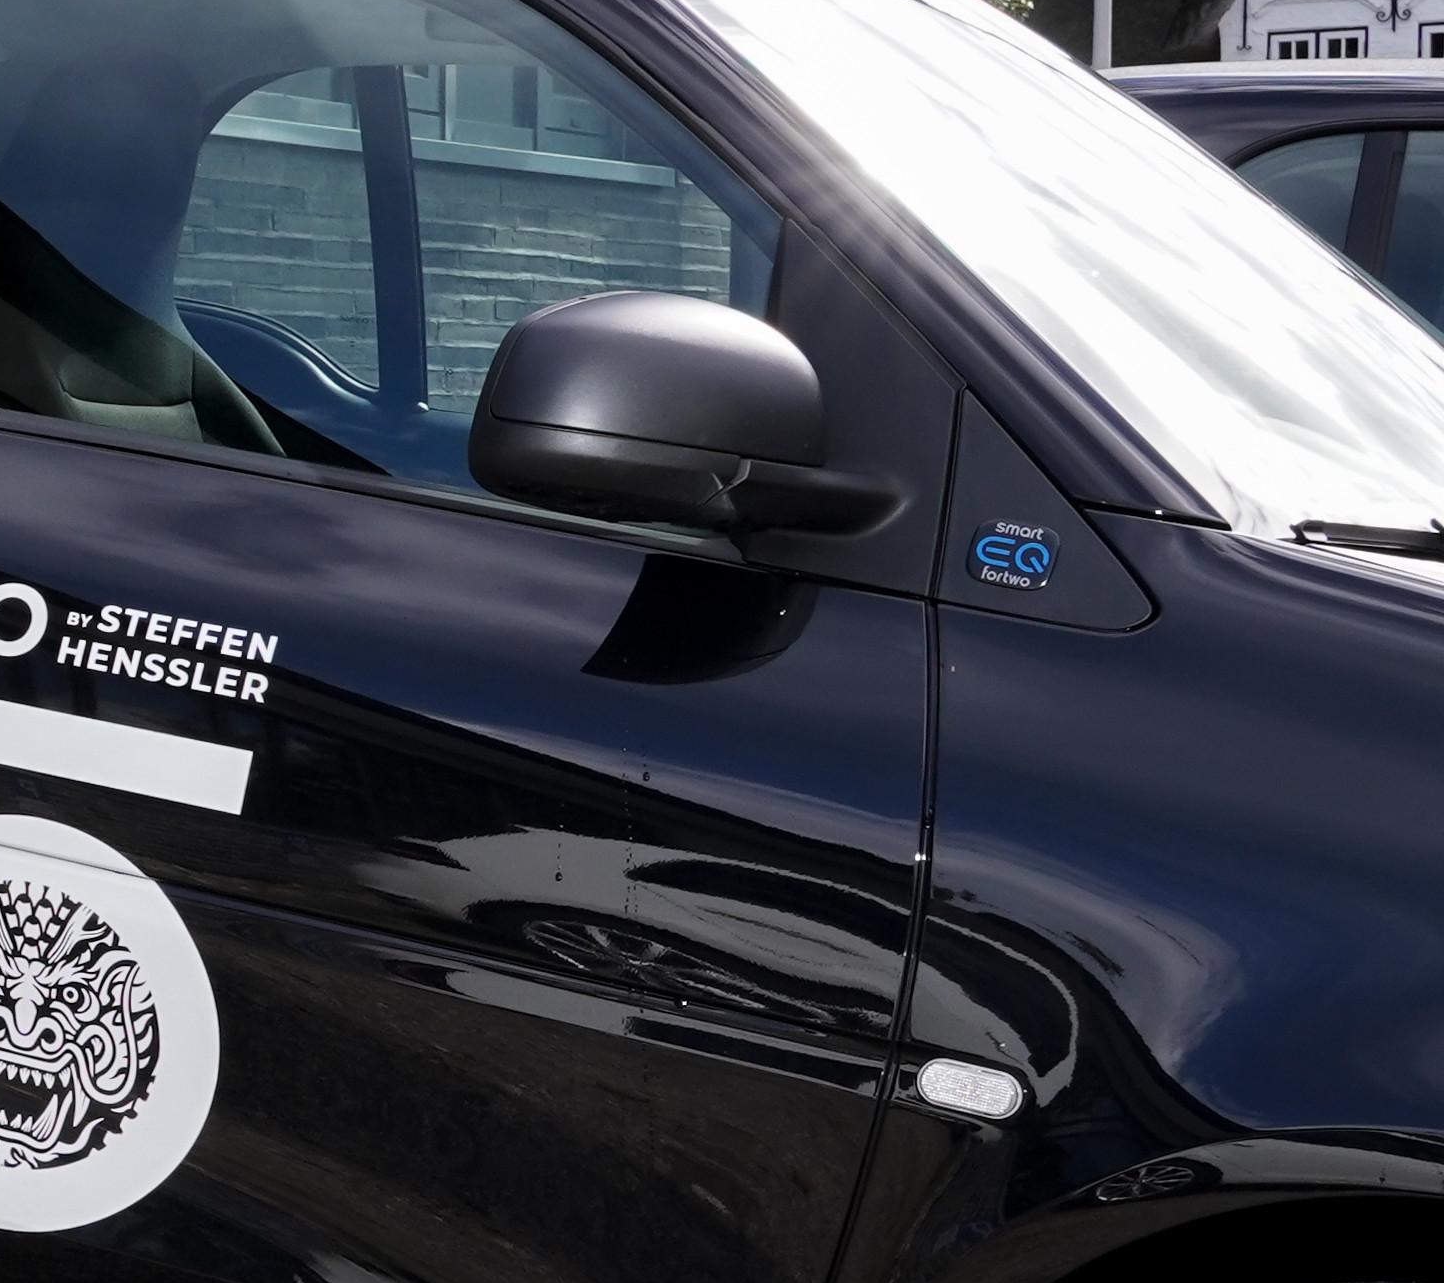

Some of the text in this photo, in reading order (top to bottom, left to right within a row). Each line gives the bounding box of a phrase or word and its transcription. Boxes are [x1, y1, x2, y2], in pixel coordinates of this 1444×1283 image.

[994, 521, 1045, 541] smart
[976, 535, 1050, 574] EQ
[979, 565, 1032, 588] fortwo
[66, 611, 94, 628] BY
[96, 604, 279, 664] STEFFEN
[57, 636, 269, 705] HENSSLER
